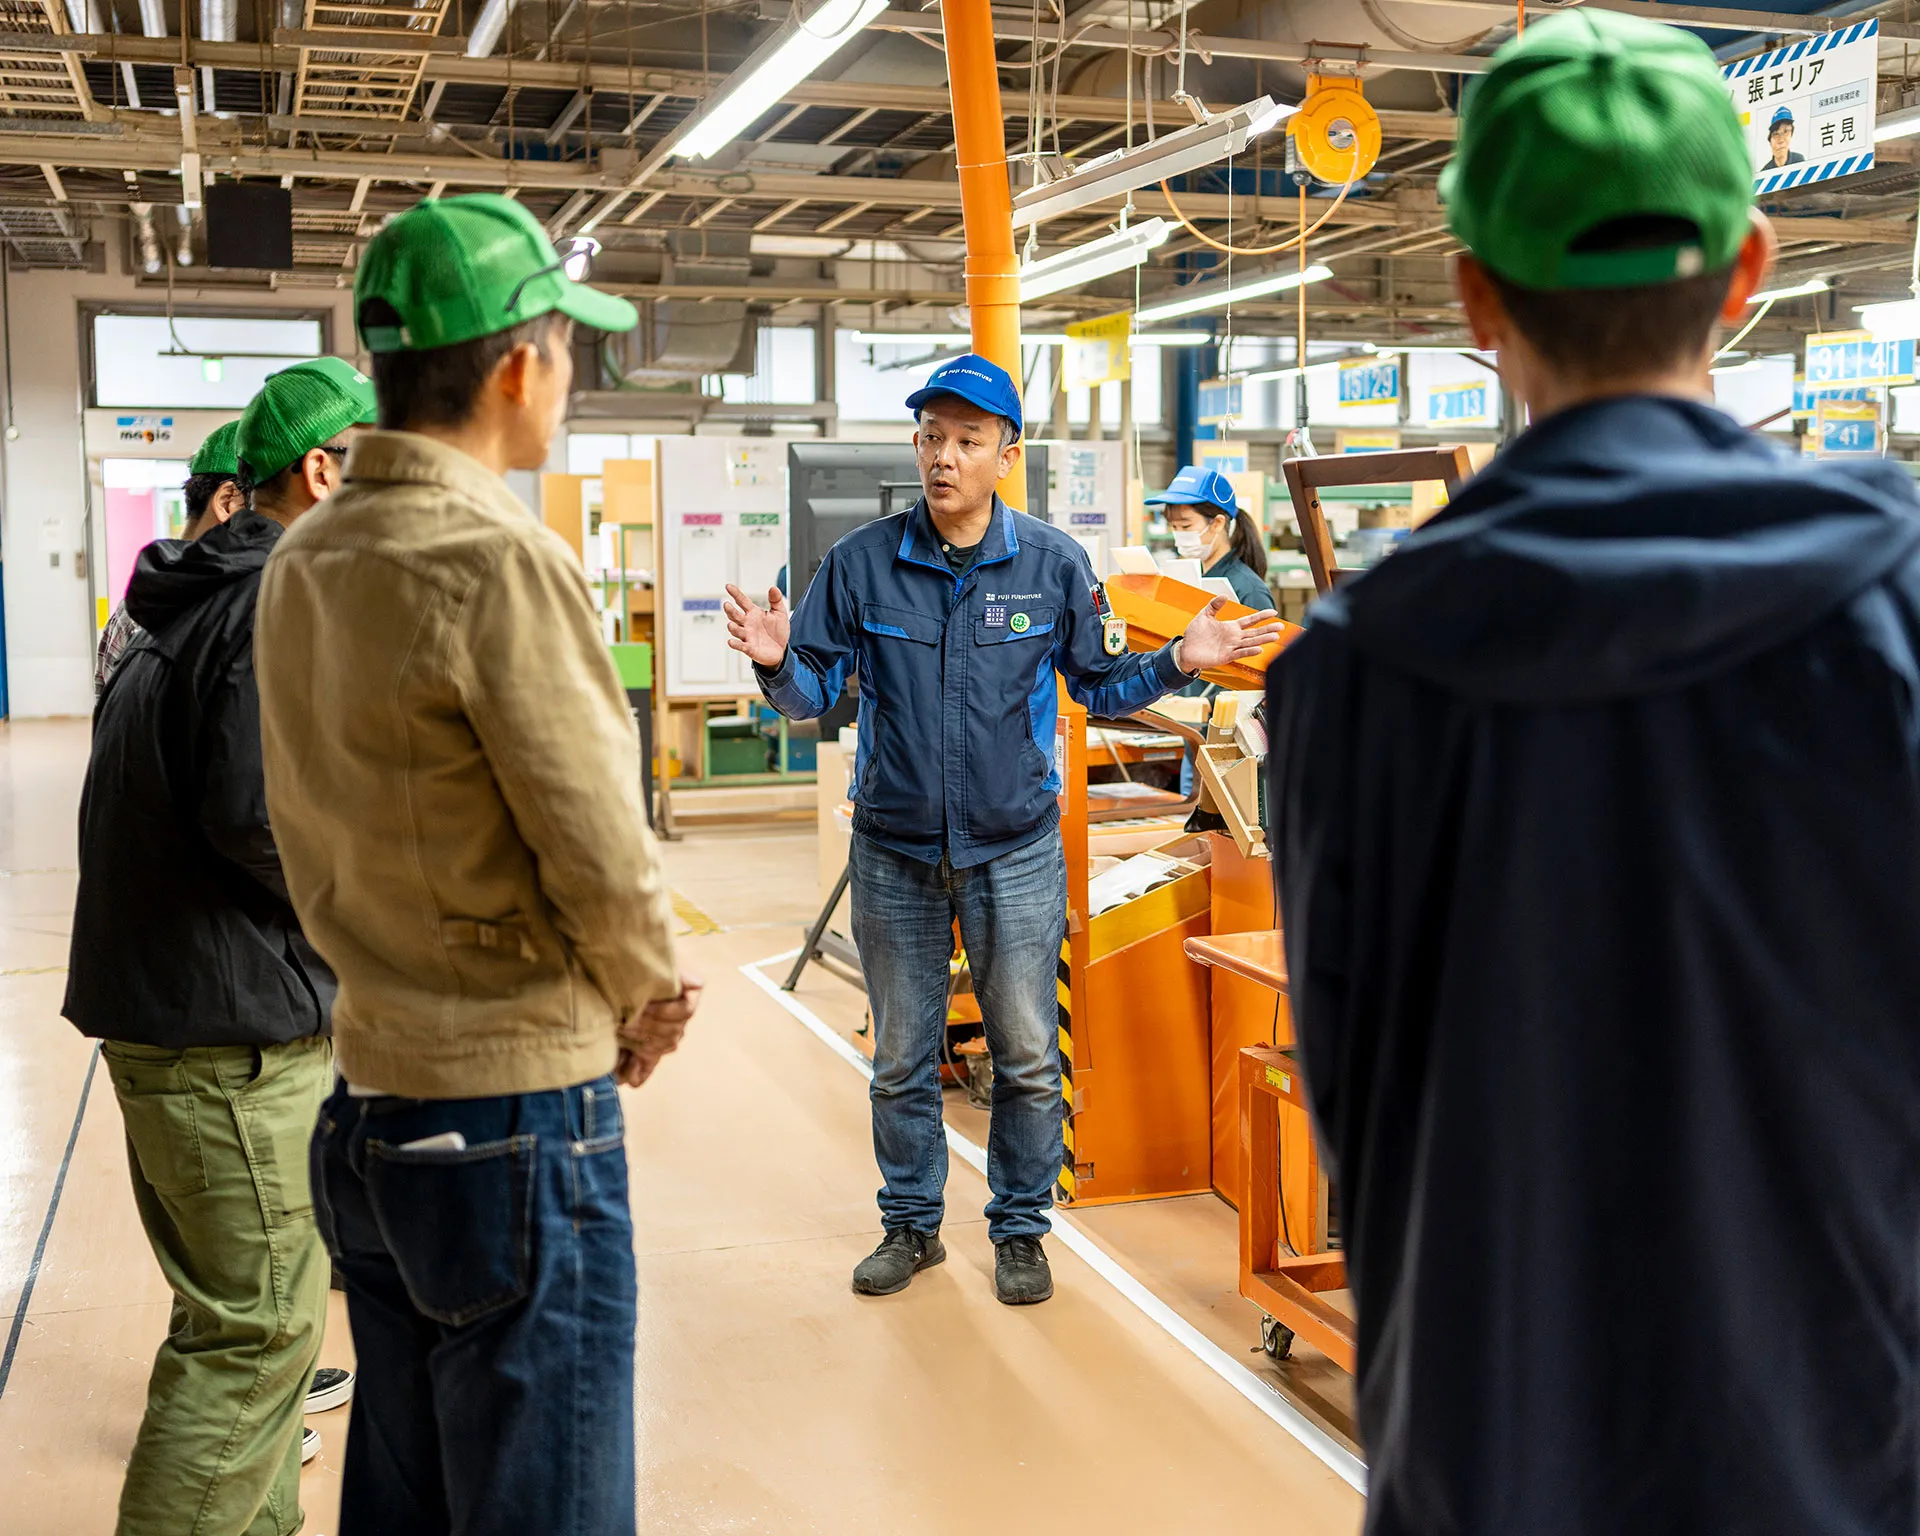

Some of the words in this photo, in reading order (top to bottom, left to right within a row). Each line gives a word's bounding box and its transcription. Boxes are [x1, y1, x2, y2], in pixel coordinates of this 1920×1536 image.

[1729, 58, 1825, 104] 張エリア
[1820, 116, 1856, 148] 吉見
[1869, 341, 1900, 375] 41
[961, 368, 992, 382] FURNITURE
[1343, 369, 1362, 400] 15
[1371, 365, 1394, 398] 29
[1436, 393, 1448, 420] 2
[1461, 389, 1481, 416] 13
